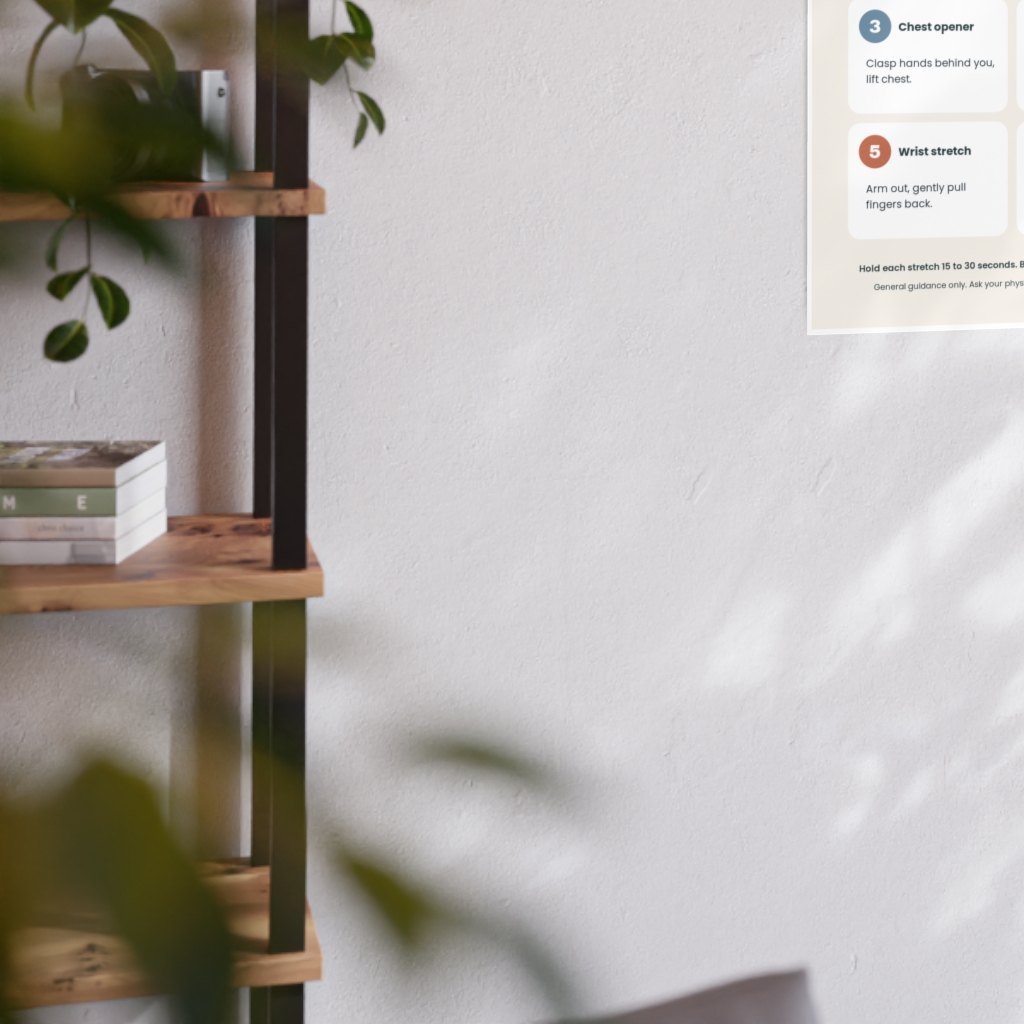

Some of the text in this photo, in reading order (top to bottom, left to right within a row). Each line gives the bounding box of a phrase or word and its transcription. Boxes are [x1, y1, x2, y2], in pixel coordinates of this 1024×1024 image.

[869, 19, 881, 34] 3
[898, 22, 975, 35] Chest opener
[865, 58, 995, 71] Clasp hands behind you,
[866, 74, 912, 84] lift chest.
[869, 144, 881, 159] 5
[898, 145, 972, 157] Wrist stretch
[865, 182, 966, 196] Arm out, gently pull
[865, 198, 933, 212] fingers back.
[859, 264, 881, 273] Hold
[882, 263, 906, 272] each
[907, 262, 940, 272] stretch
[941, 262, 951, 271] 15
[952, 262, 963, 270] to
[964, 261, 976, 270] 30
[977, 260, 1018, 270] seconds.
[873, 282, 907, 291] General
[907, 282, 947, 293] guidance
[948, 281, 968, 291] only.
[968, 280, 983, 288] Ask
[984, 281, 1003, 290] your
